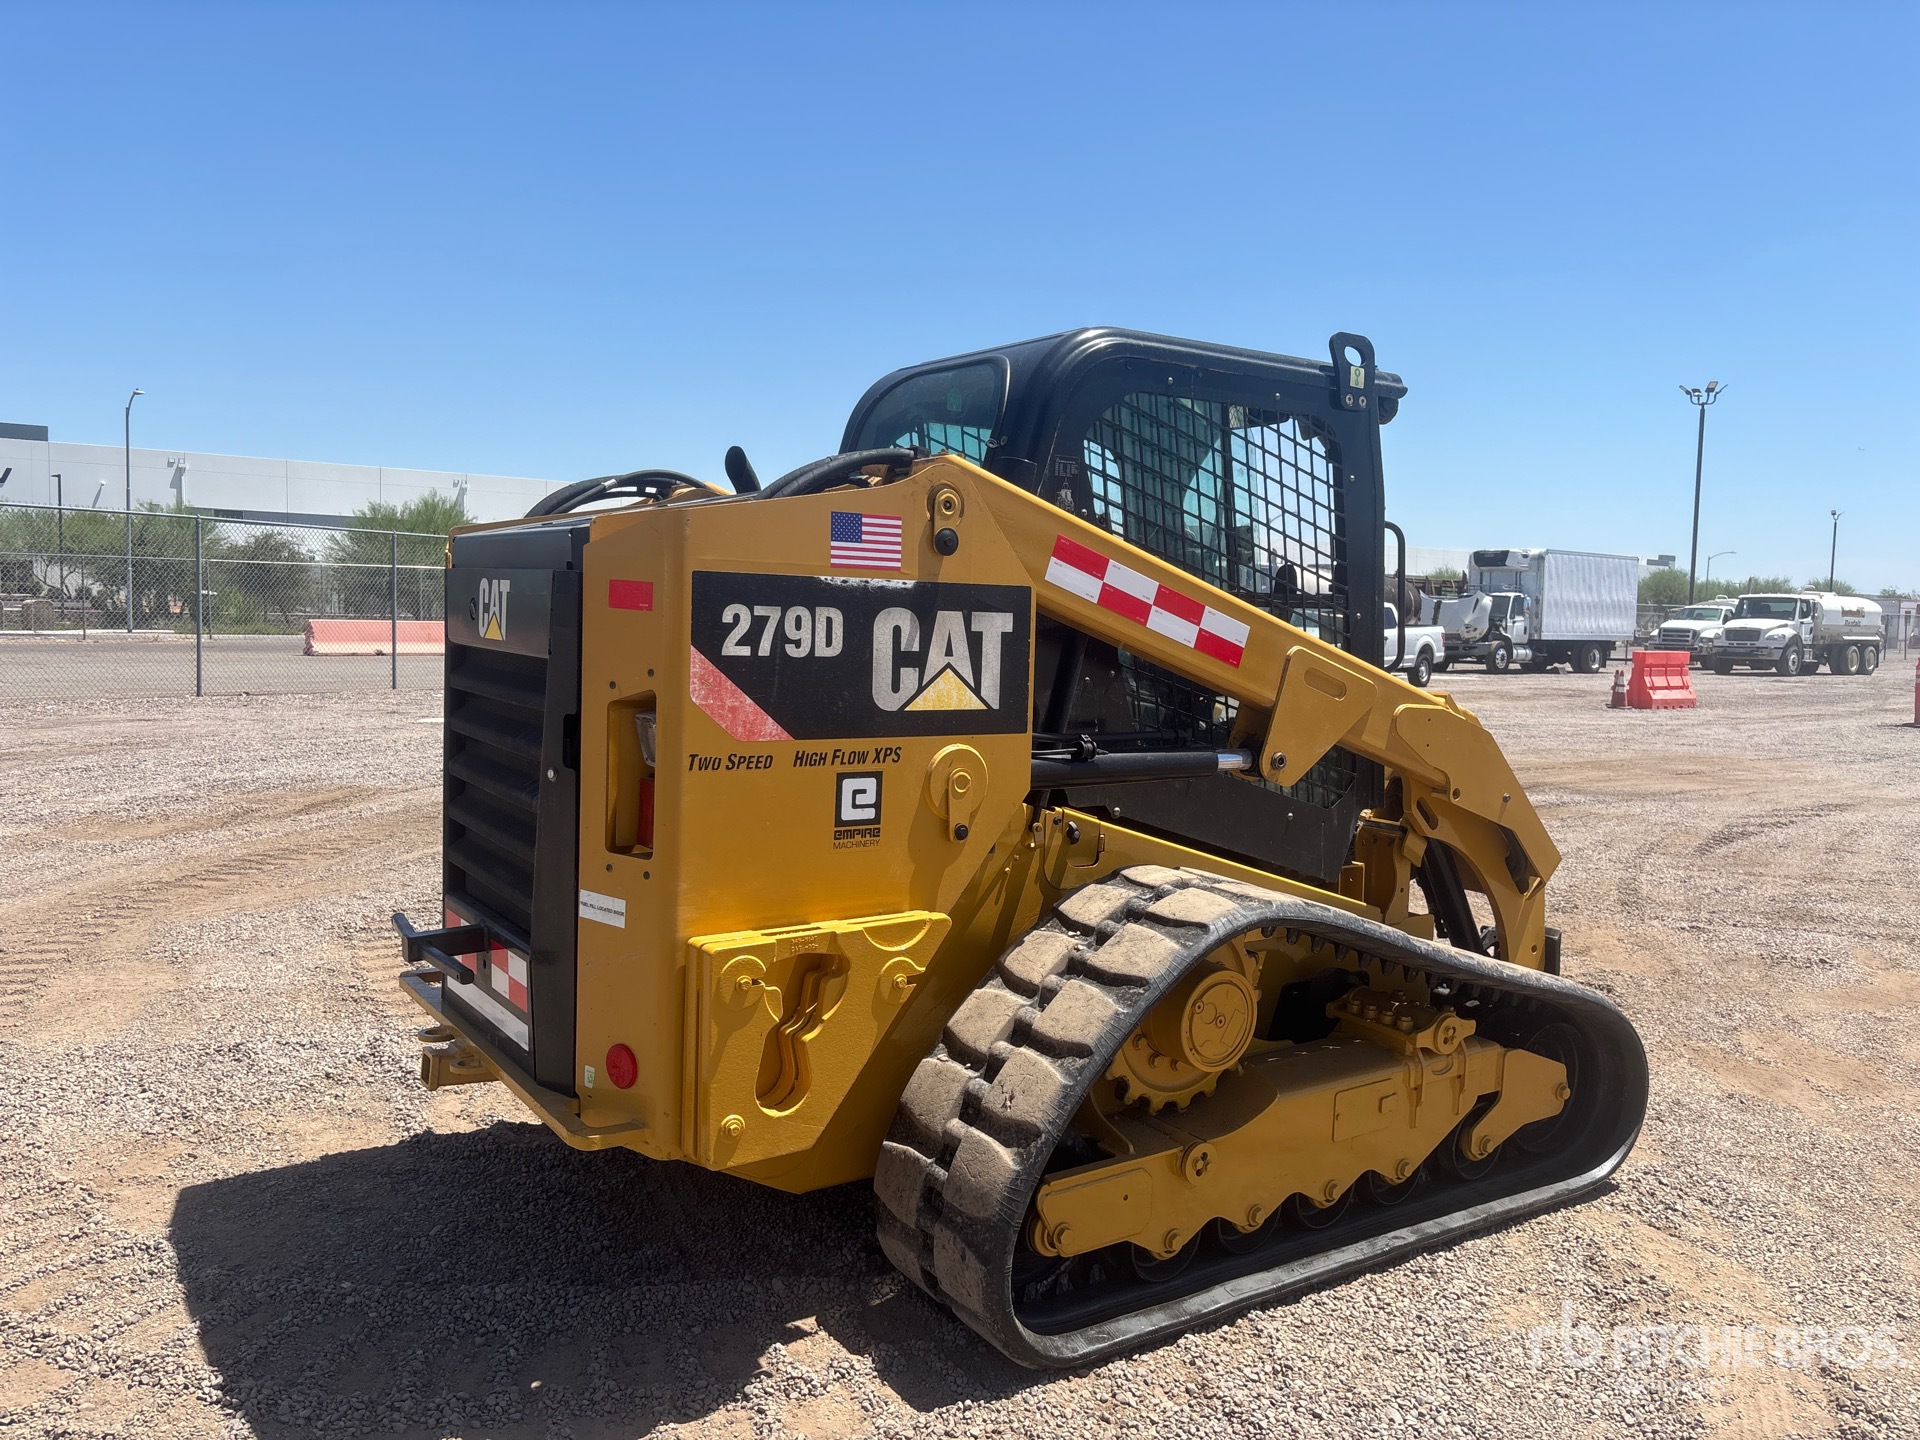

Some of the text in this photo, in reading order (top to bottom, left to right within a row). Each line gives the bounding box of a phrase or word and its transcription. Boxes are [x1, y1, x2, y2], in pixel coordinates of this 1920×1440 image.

[478, 577, 511, 641] CAT
[721, 603, 844, 658] 279D
[872, 606, 1014, 712] CAT
[872, 746, 903, 764] XPS
[832, 839, 881, 850] MACHINERY
